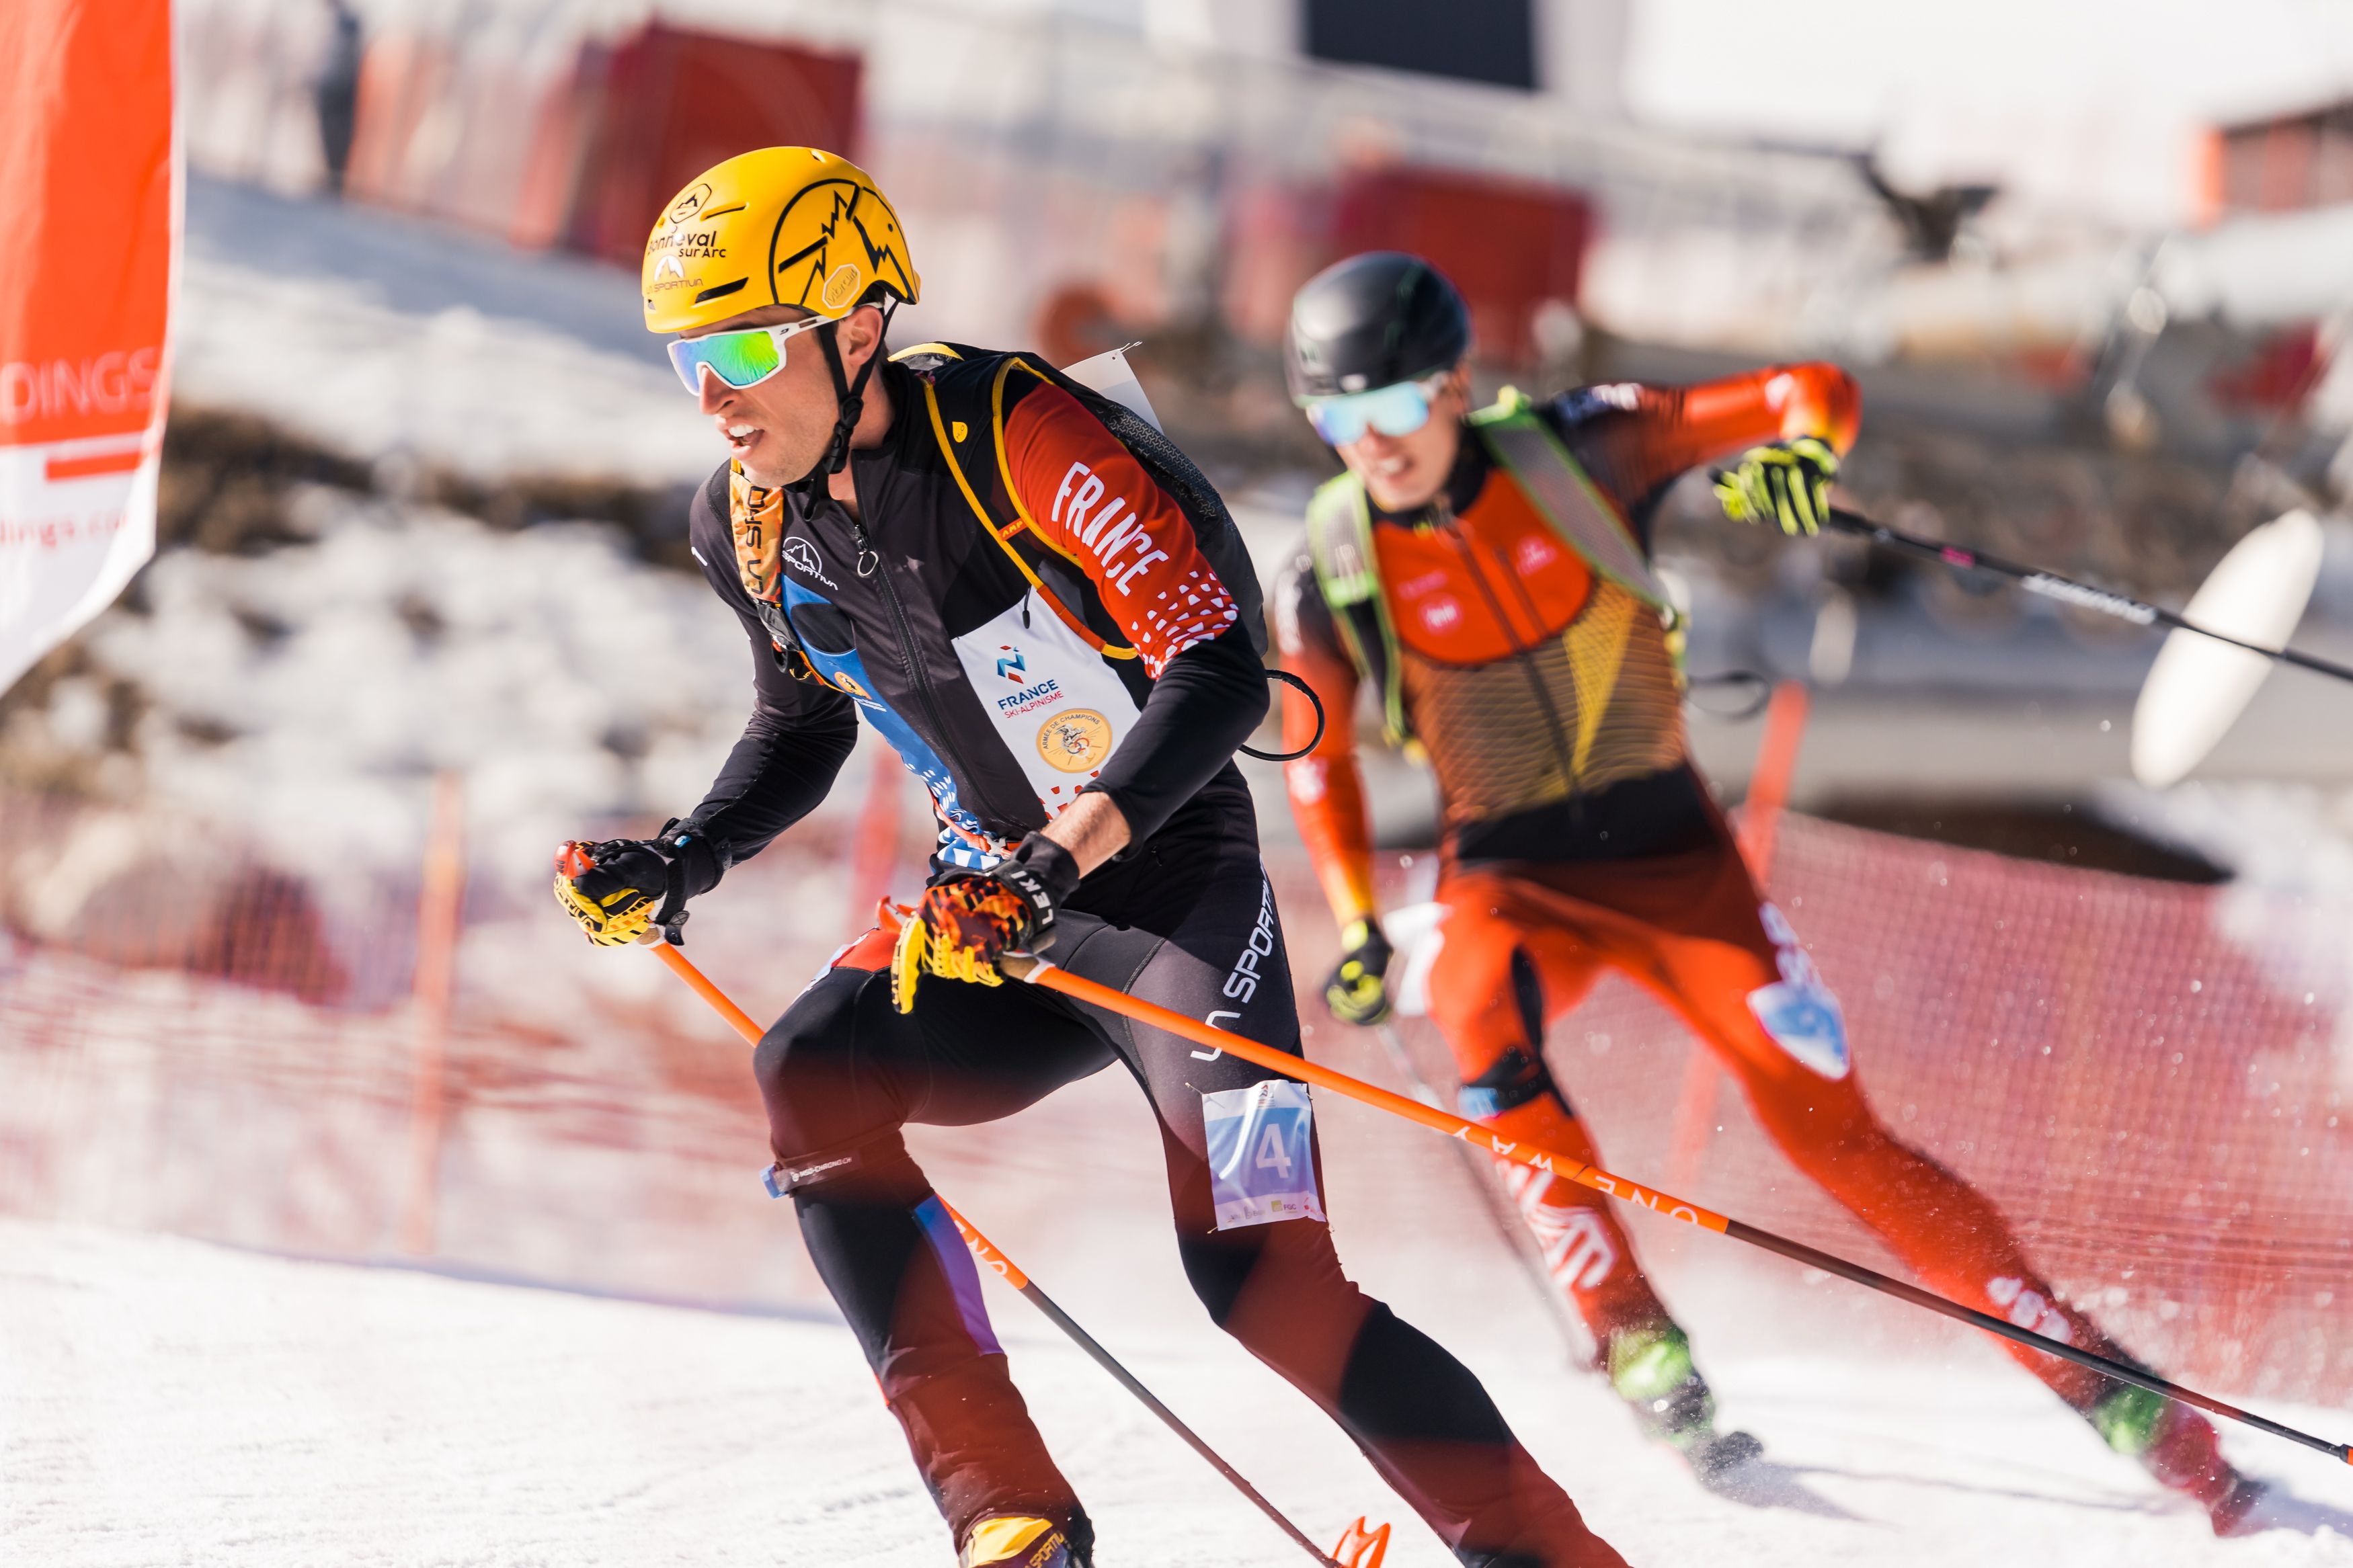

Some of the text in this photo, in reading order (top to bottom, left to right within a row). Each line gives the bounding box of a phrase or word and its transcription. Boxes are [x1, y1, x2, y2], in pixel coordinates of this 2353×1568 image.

[678, 247, 726, 257] sur Arc
[1002, 521, 1023, 538] AMP
[1051, 461, 1169, 597] FRANCE
[782, 550, 838, 591] SPORTIVA
[998, 679, 1059, 710] FRANCE
[1004, 690, 1064, 718] SKI-ALPINISME
[1060, 714, 1101, 725] CHAMPIONS
[1010, 870, 1053, 925] LEKI
[1256, 1123, 1291, 1178] 4
